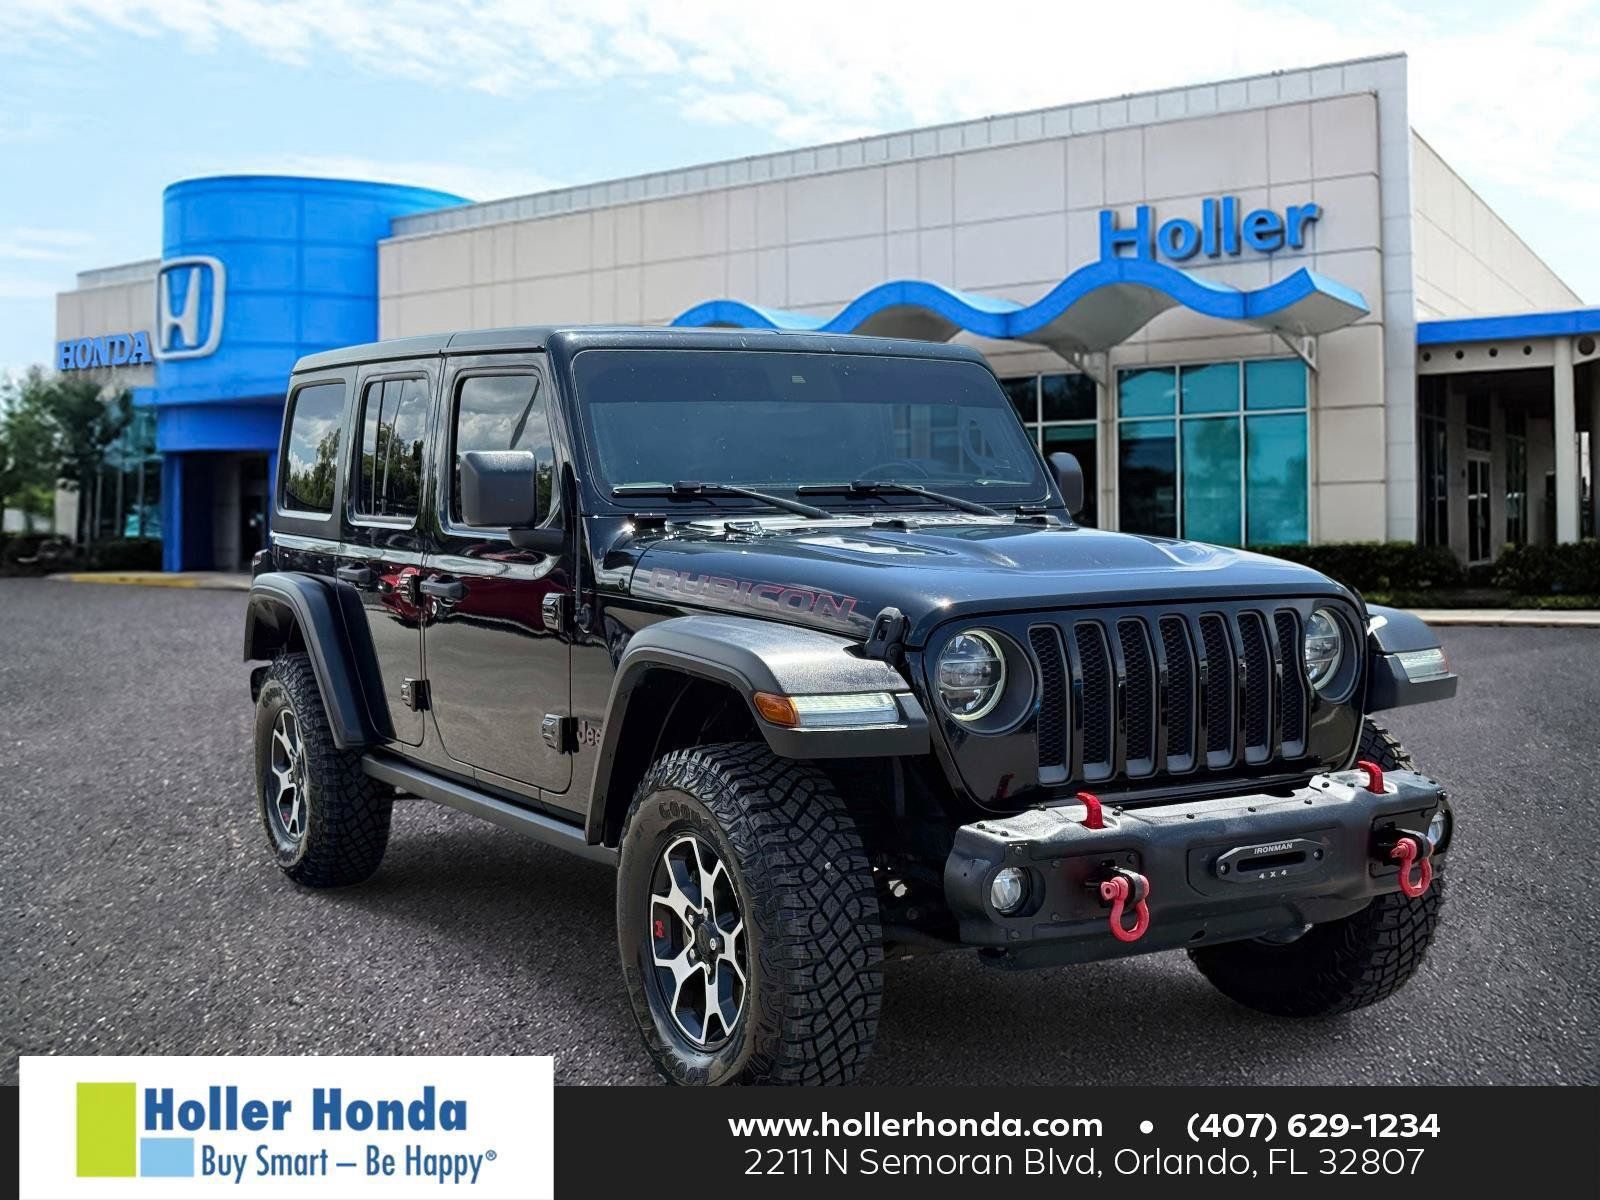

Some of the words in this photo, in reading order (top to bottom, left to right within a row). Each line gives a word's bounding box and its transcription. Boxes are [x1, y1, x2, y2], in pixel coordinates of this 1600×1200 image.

[1098, 195, 1323, 262] Holler
[58, 331, 152, 370] HONDA
[649, 568, 857, 621] RUBICON
[1254, 843, 1293, 855] IRONMAN
